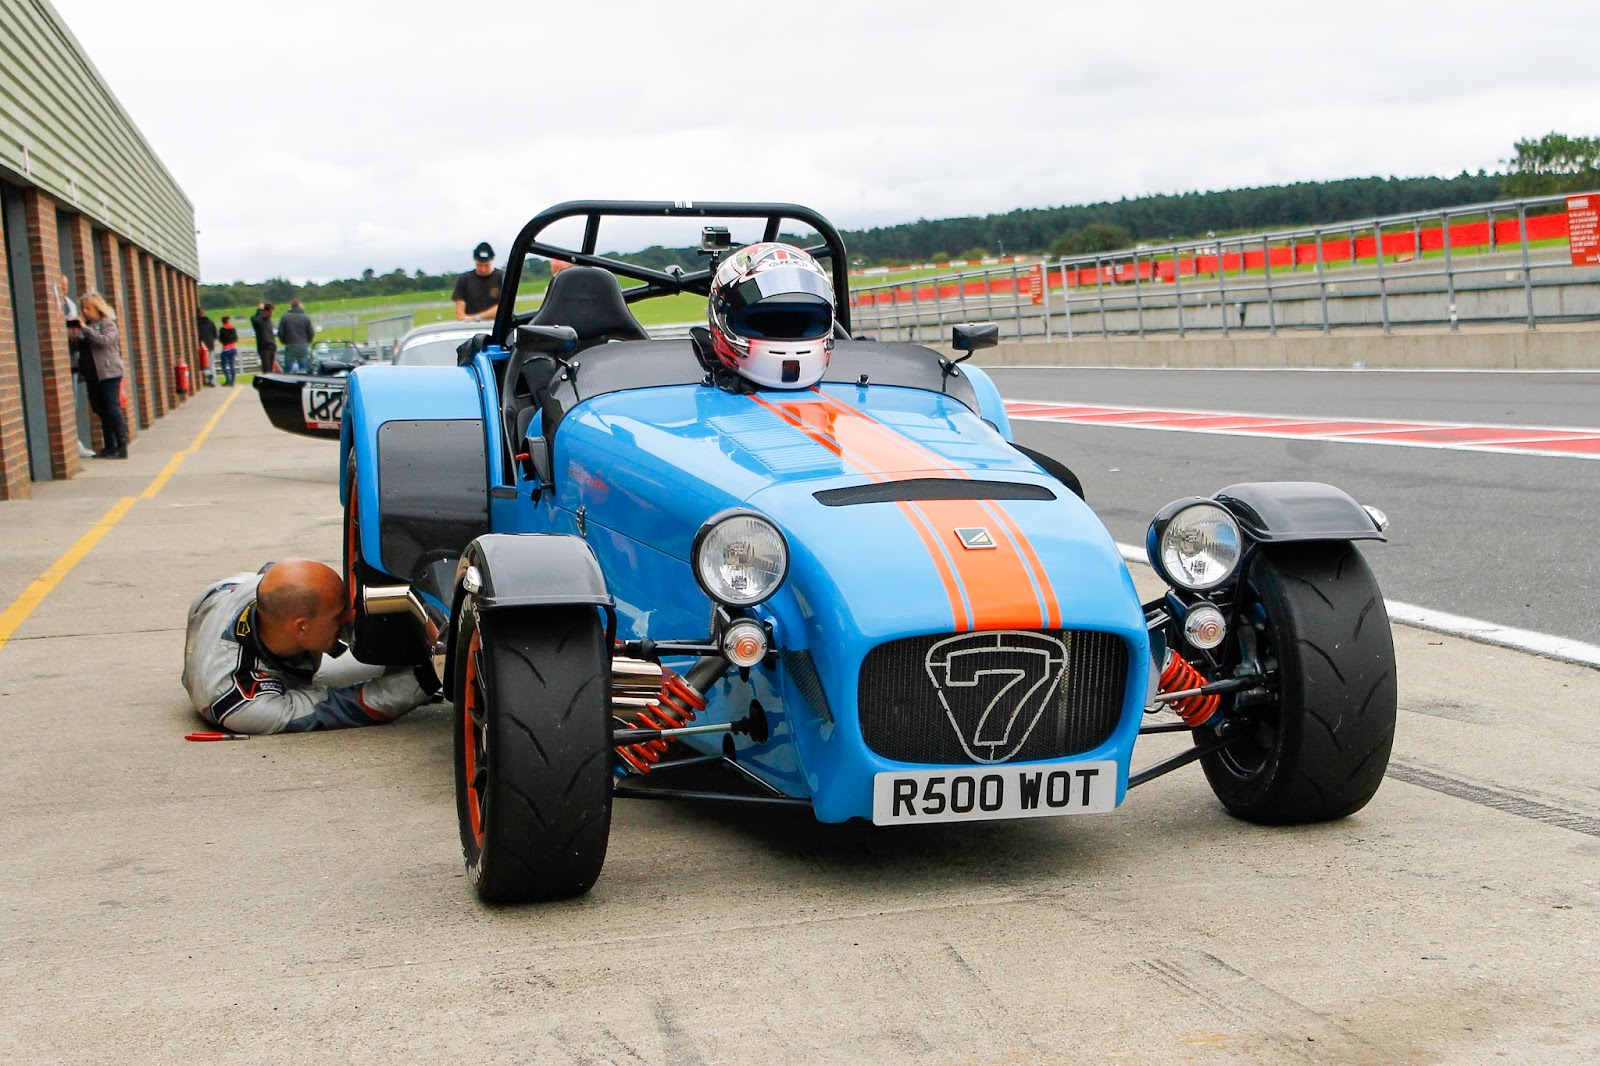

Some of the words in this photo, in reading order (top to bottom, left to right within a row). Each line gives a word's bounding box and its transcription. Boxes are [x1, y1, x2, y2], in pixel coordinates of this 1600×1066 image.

[946, 646, 1050, 747] 7
[892, 774, 1004, 817] R500
[1019, 768, 1099, 810] WOT
